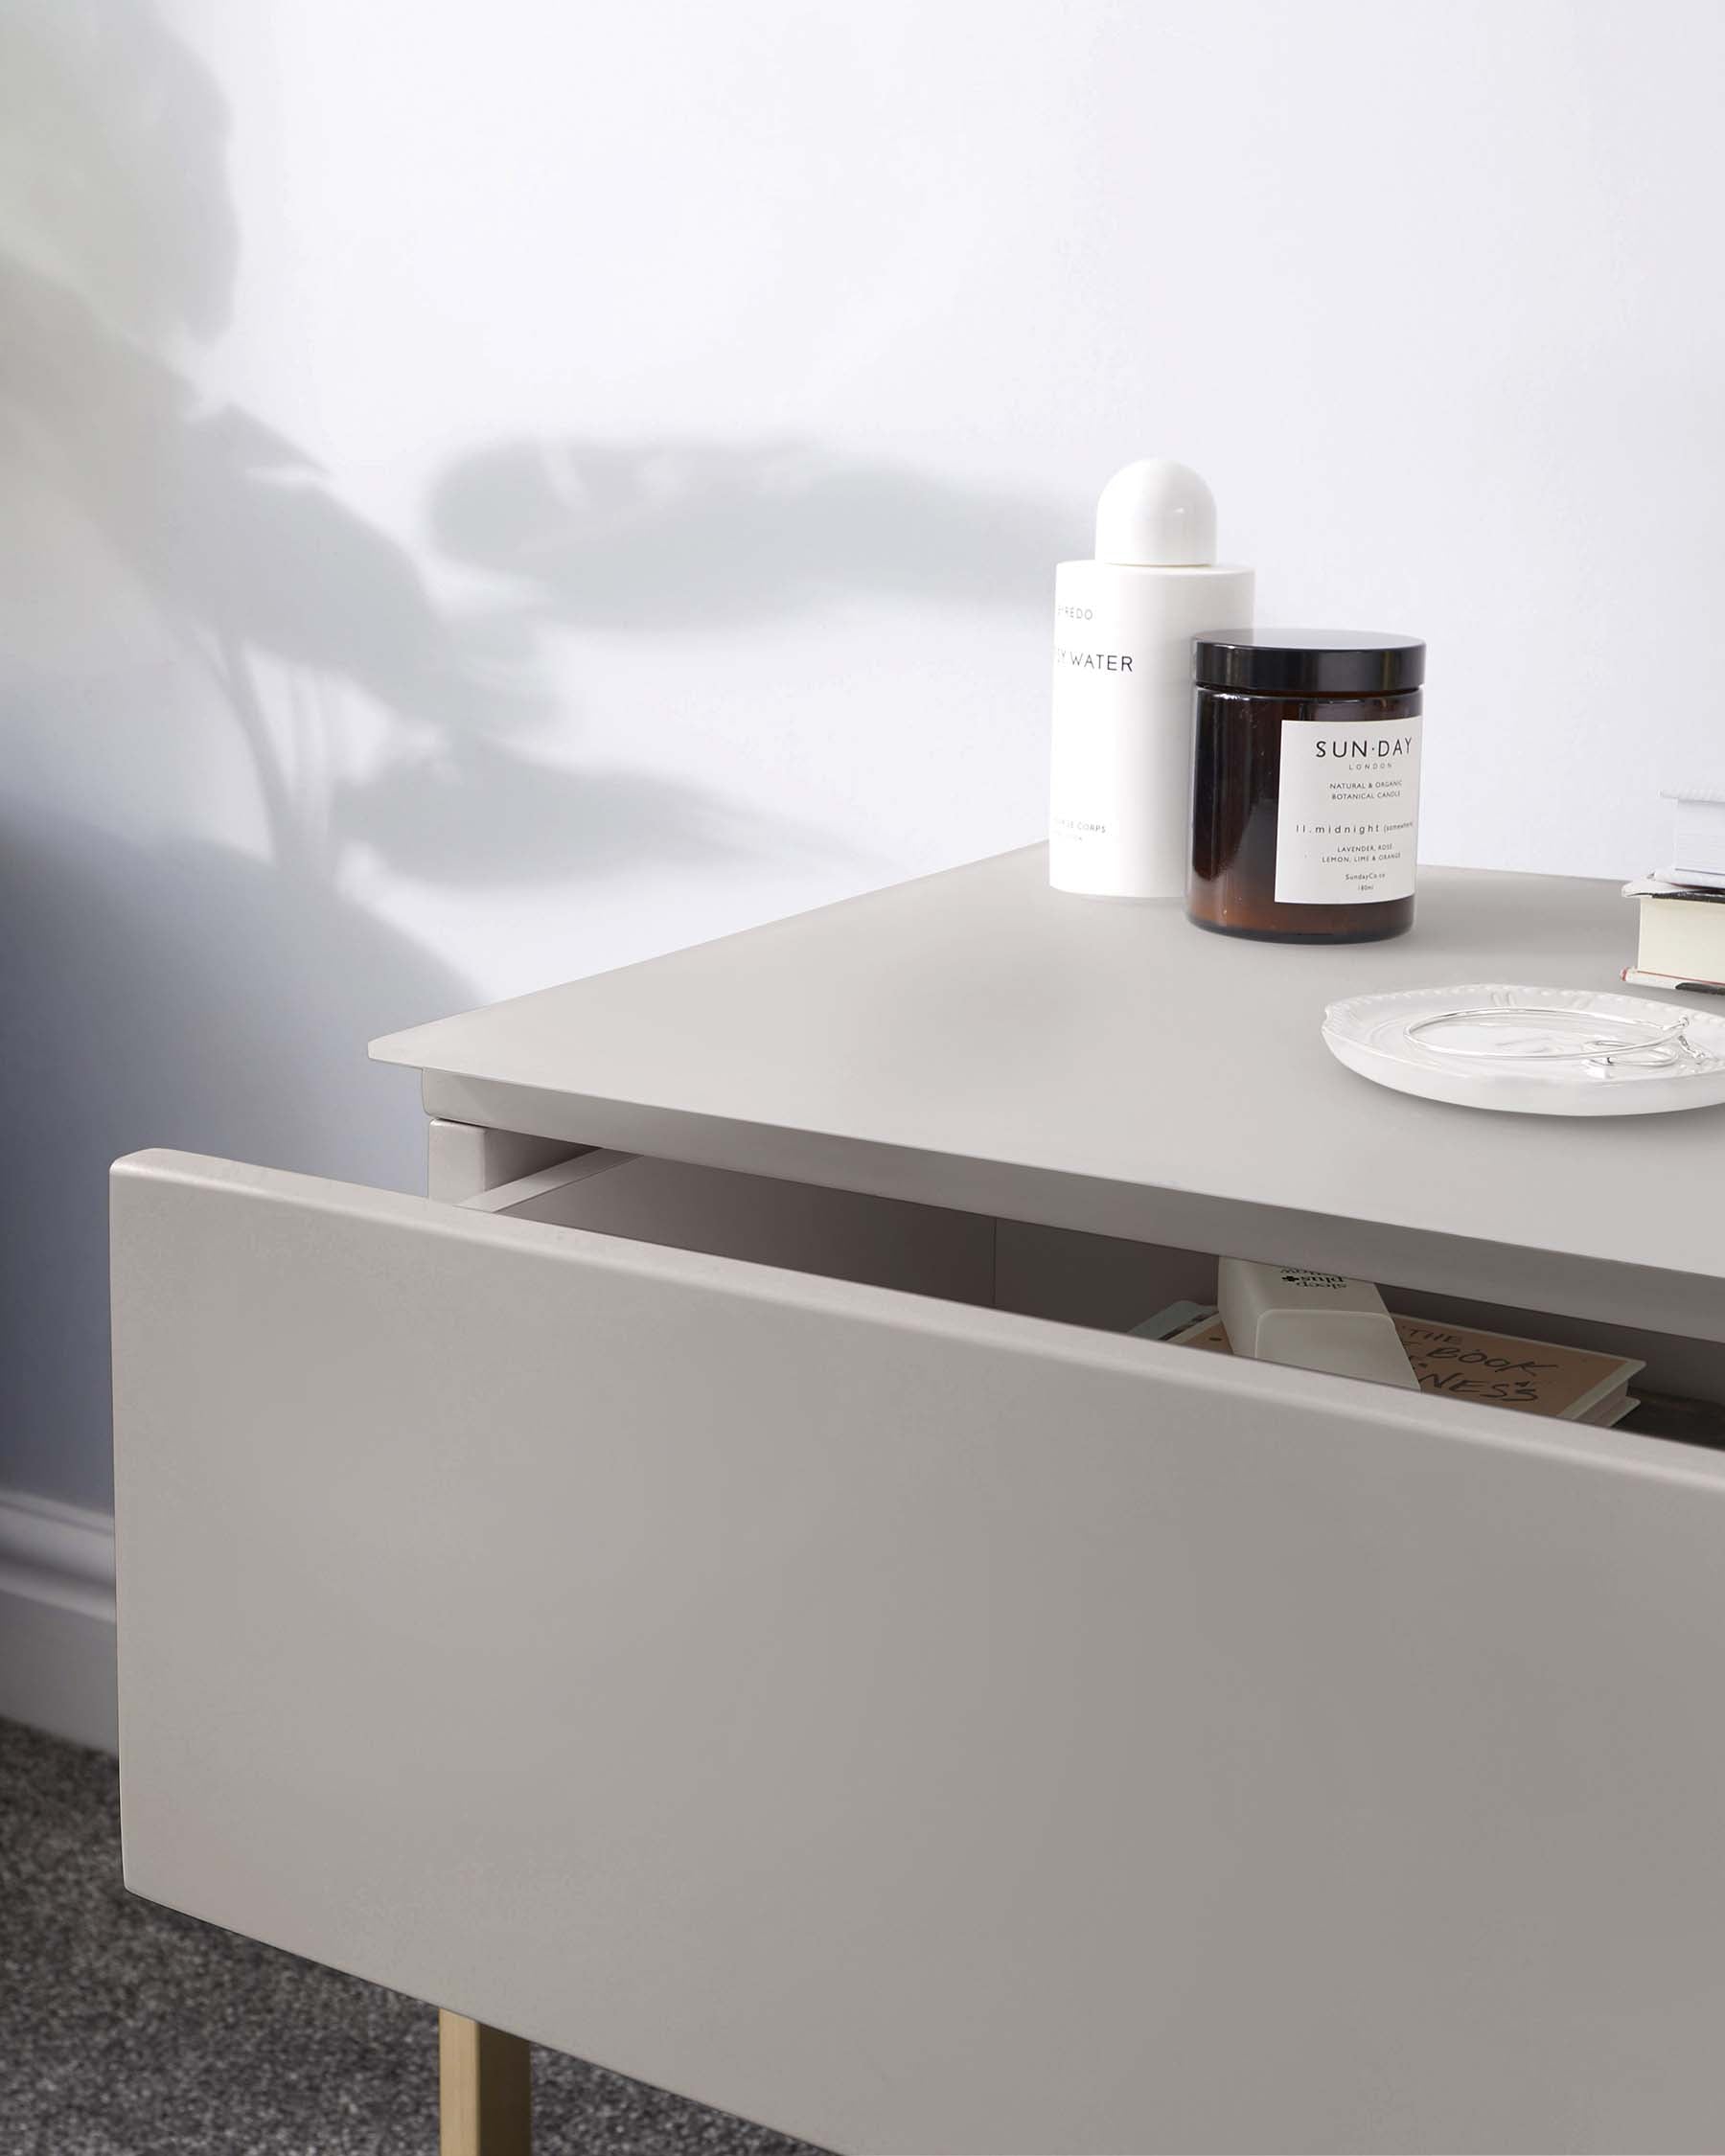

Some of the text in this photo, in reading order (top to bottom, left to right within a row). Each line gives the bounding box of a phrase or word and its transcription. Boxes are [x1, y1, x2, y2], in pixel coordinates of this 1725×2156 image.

[1070, 652, 1134, 673] WATER
[1349, 763, 1392, 771] LONDON
[1375, 780, 1403, 789] ORGANIC
[1377, 791, 1401, 799] CANDLE
[1410, 1328, 1460, 1344] THE
[1426, 1346, 1559, 1377] BOOK
[1417, 1372, 1539, 1402] NESS
